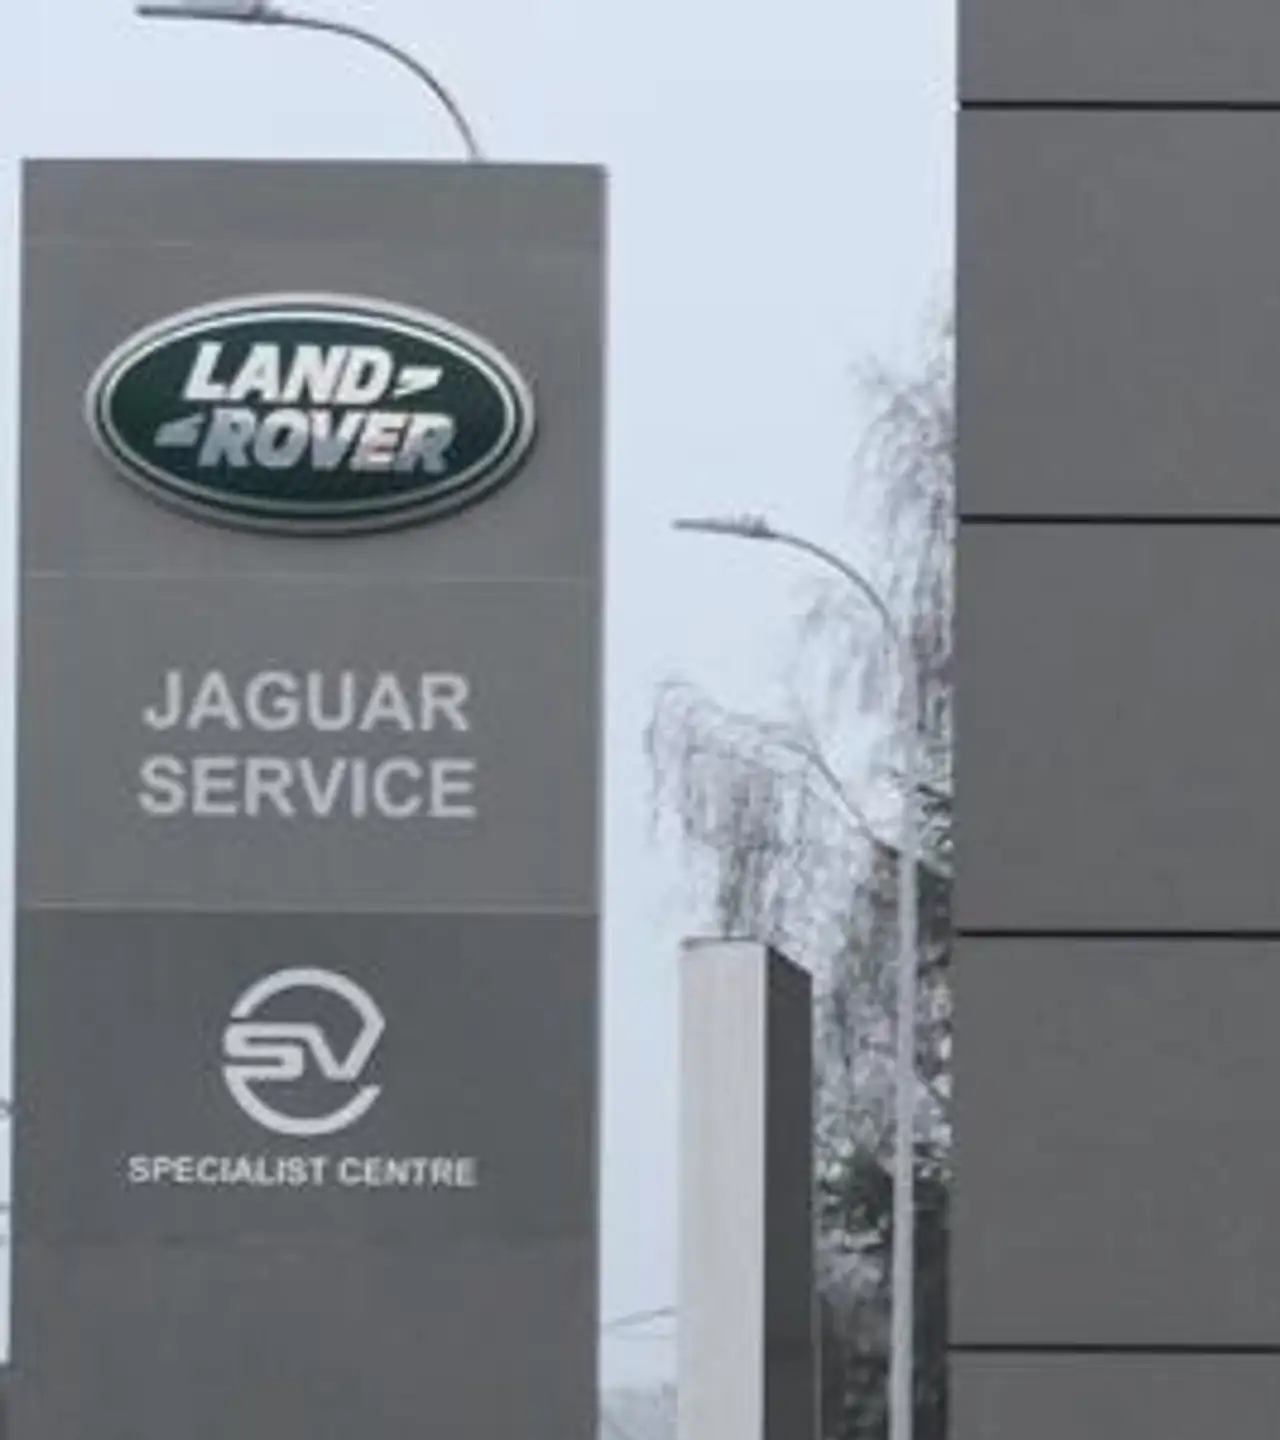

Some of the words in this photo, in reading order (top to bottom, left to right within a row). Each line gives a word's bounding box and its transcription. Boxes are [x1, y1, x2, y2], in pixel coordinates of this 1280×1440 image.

[183, 341, 392, 404] LAND
[199, 409, 455, 474] ROVER
[143, 670, 469, 732] JAGUAR
[138, 754, 476, 819] SERVICE
[127, 1154, 328, 1187] SPECIALIST
[337, 1154, 477, 1188] CENTRE
